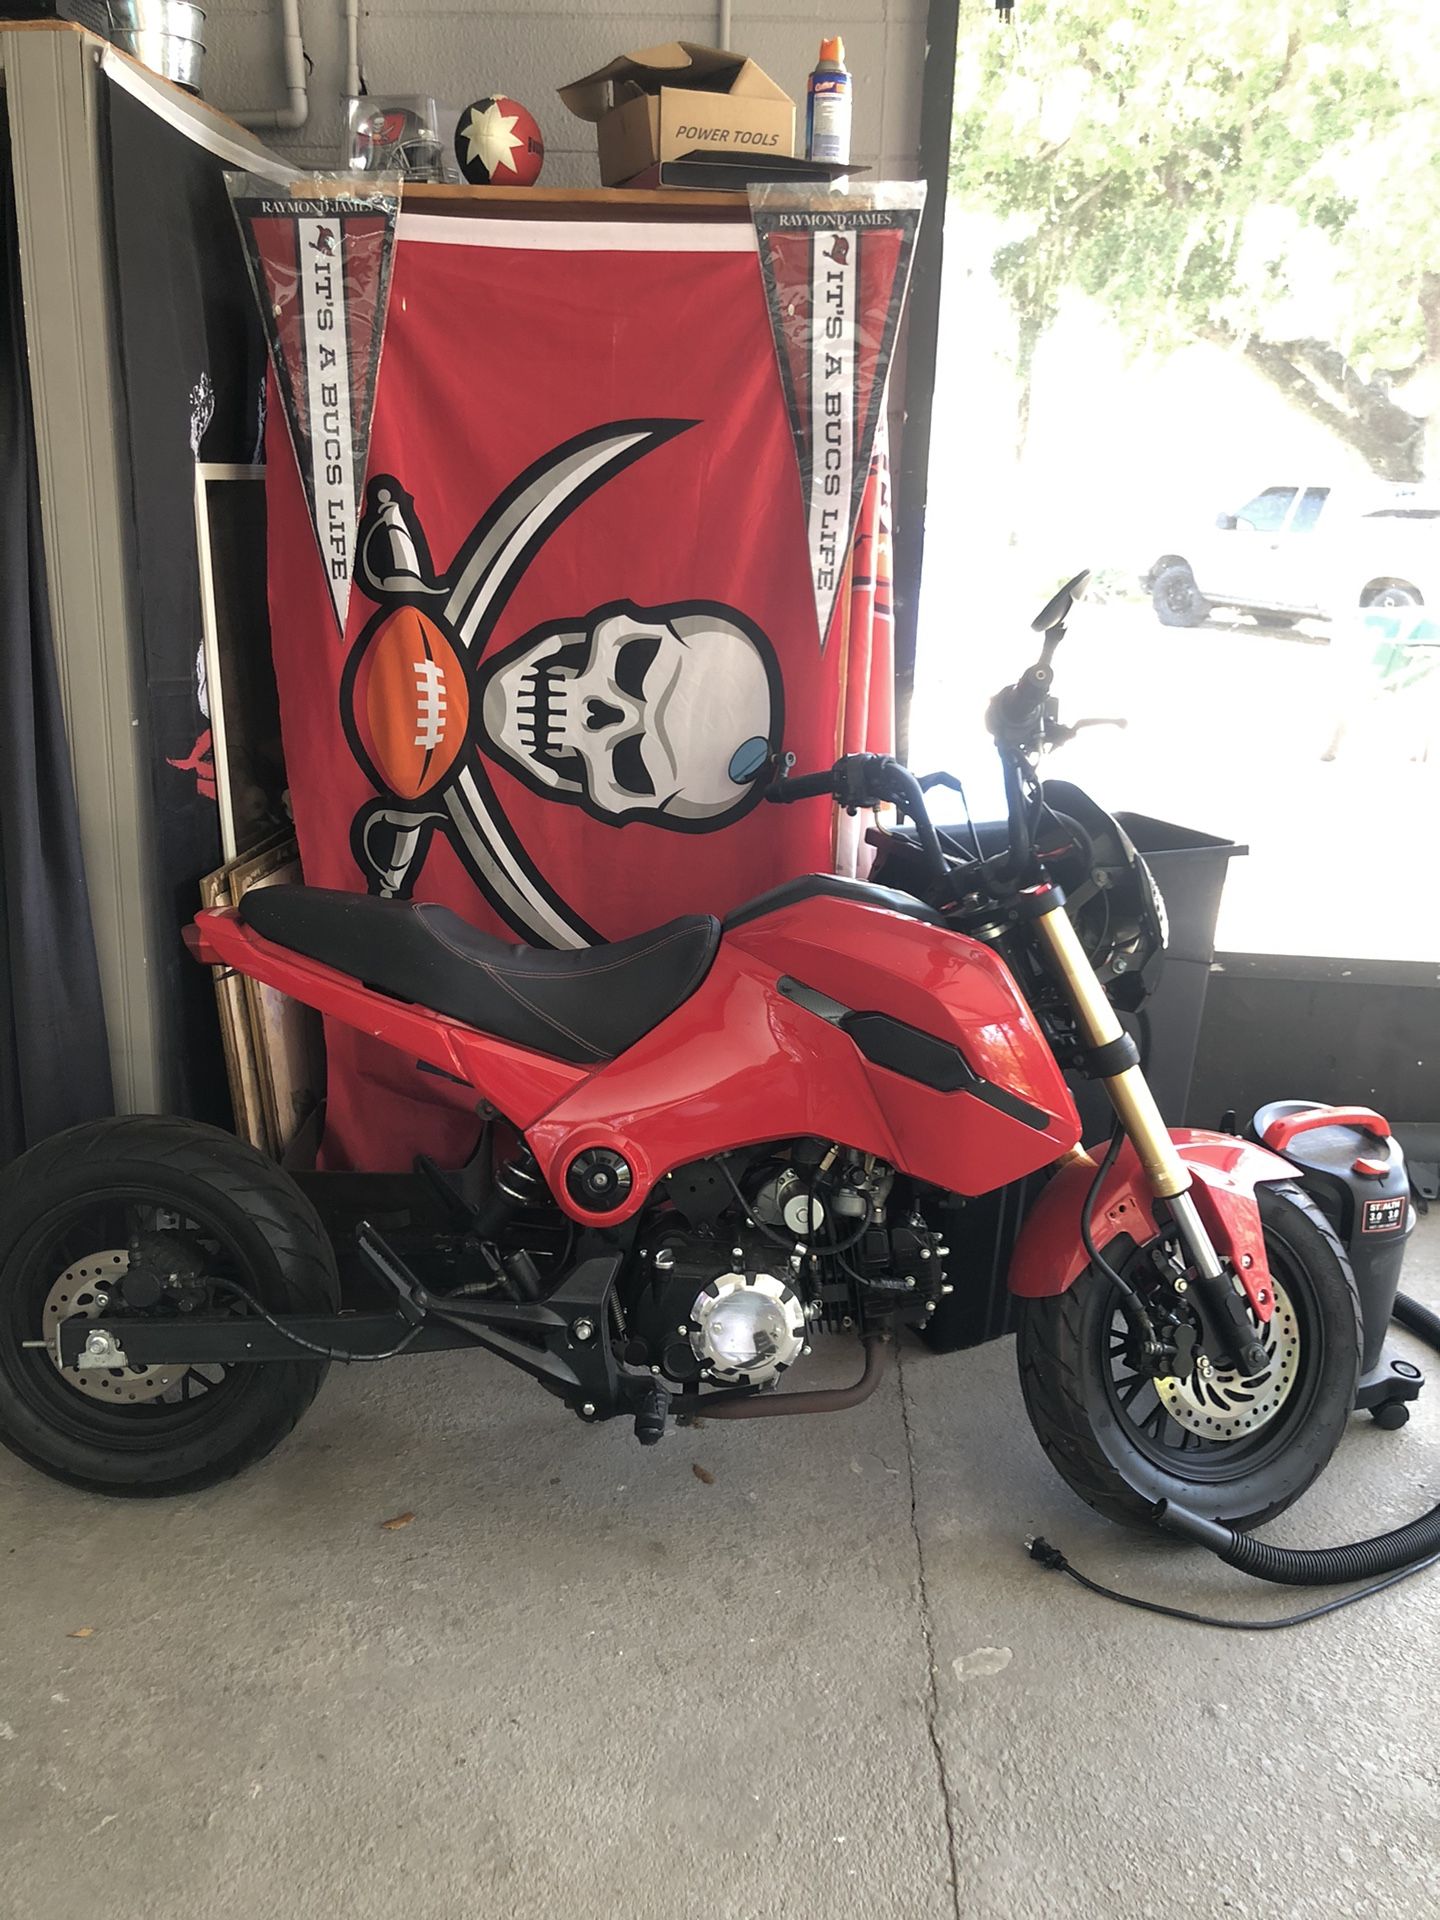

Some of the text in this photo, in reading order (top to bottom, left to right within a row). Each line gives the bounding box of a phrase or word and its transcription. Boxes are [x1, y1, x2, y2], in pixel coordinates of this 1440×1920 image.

[675, 126, 780, 146] POWER TOOLS
[262, 201, 374, 213] RAYMOND JAMES
[779, 213, 892, 226] RAYMOND JAMES
[314, 263, 348, 580] IT'S A BUCS LIFE
[817, 271, 845, 591] IT'S A BUCS LIFE
